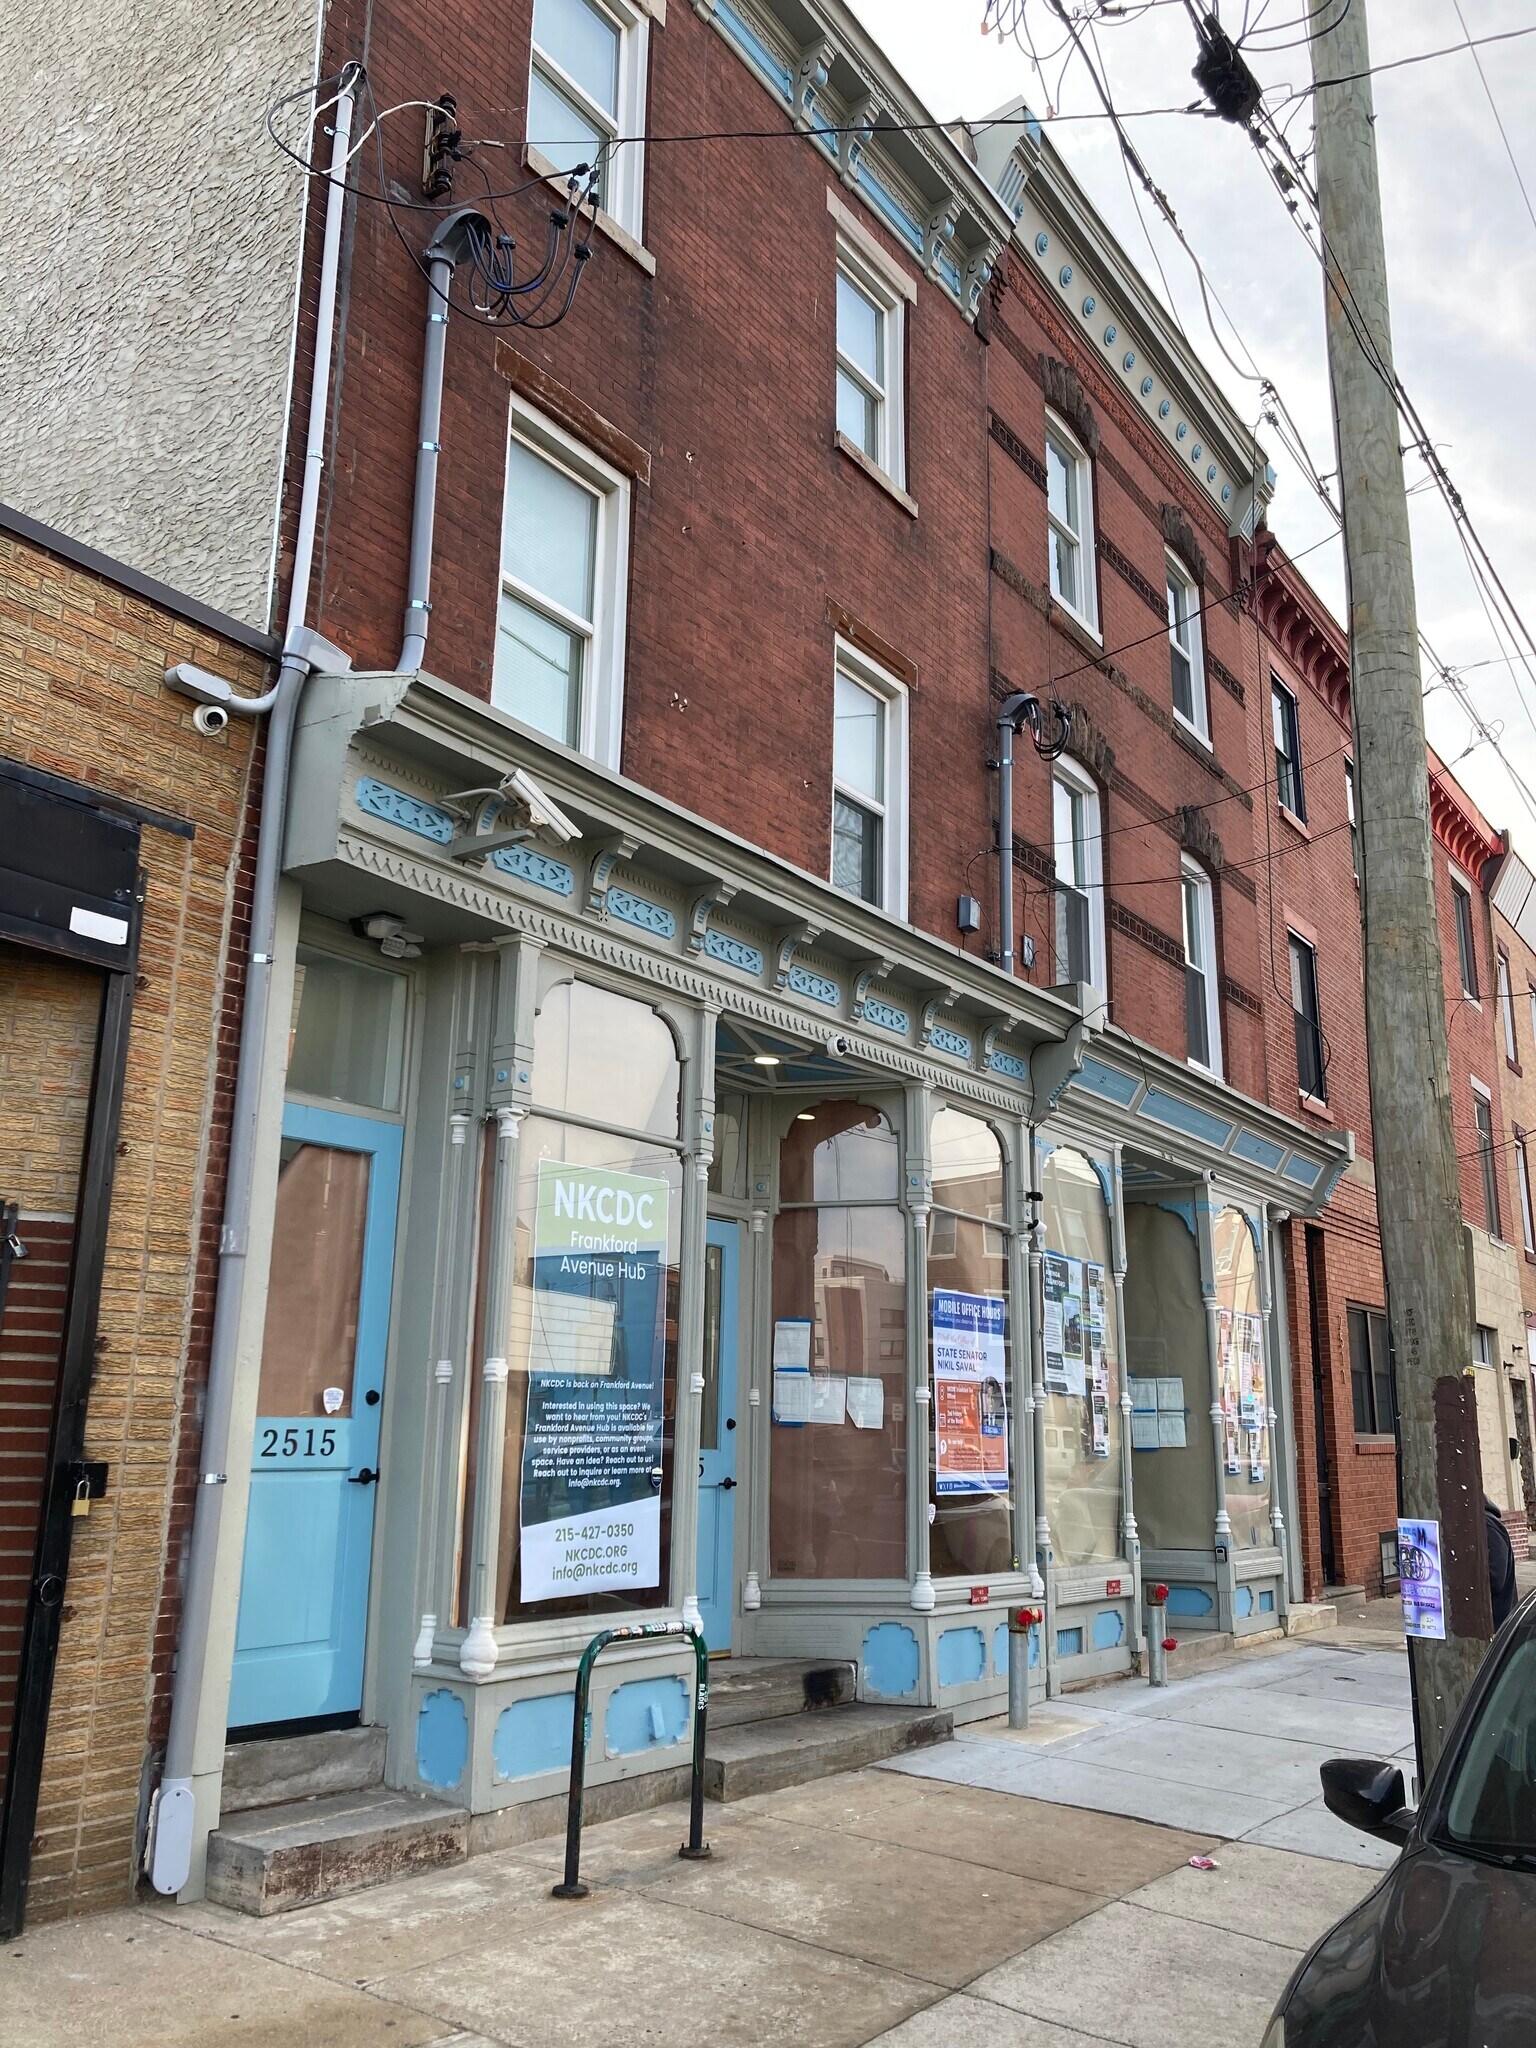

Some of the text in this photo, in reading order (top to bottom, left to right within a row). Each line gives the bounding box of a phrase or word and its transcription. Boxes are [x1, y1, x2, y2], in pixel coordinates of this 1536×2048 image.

[554, 1179, 654, 1230] NKCDC
[571, 1231, 638, 1255] Frankford
[560, 1256, 646, 1280] Avenue Hub
[938, 1299, 1001, 1320] MOBILE OFFICE HOURS
[937, 1347, 987, 1361] STATE SENATOR
[937, 1360, 977, 1372] NIKIL SAVAL
[540, 1379, 564, 1388] NKCDC
[566, 1379, 572, 1388] is
[573, 1380, 589, 1388] back
[600, 1380, 630, 1389] Frankford
[631, 1381, 654, 1390] Avenue!
[542, 1401, 576, 1410] Interested
[578, 1402, 585, 1410] in
[586, 1402, 604, 1412] using
[606, 1402, 618, 1410] this
[619, 1402, 640, 1413] space?
[574, 1413, 589, 1421] hear
[590, 1413, 605, 1421] from
[607, 1413, 621, 1423] you!
[535, 1424, 568, 1432] Frankford
[570, 1424, 595, 1432] Avenue
[596, 1423, 610, 1432] Hub
[612, 1424, 616, 1432] is
[618, 1424, 645, 1432] available
[260, 1428, 336, 1457] 2515
[548, 1434, 557, 1445] by
[558, 1434, 594, 1445] nonprofits,
[595, 1434, 632, 1444] community
[633, 1435, 654, 1444] groups,
[543, 1446, 568, 1454] service
[570, 1445, 602, 1456] providers,
[630, 1445, 646, 1453] event
[532, 1458, 555, 1466] space.
[557, 1457, 574, 1465] Have
[586, 1456, 604, 1464] idea?
[605, 1456, 624, 1464] Reach
[645, 1454, 654, 1463] us!
[534, 1469, 555, 1478] Reach
[557, 1469, 569, 1477] out
[570, 1468, 578, 1476] to
[579, 1467, 602, 1478] inquire
[612, 1466, 628, 1474] learn
[555, 1523, 634, 1542] 215-427-0350
[565, 1545, 628, 1562] NKCDC.ORG
[552, 1562, 638, 1582] info@nkcdc.org
